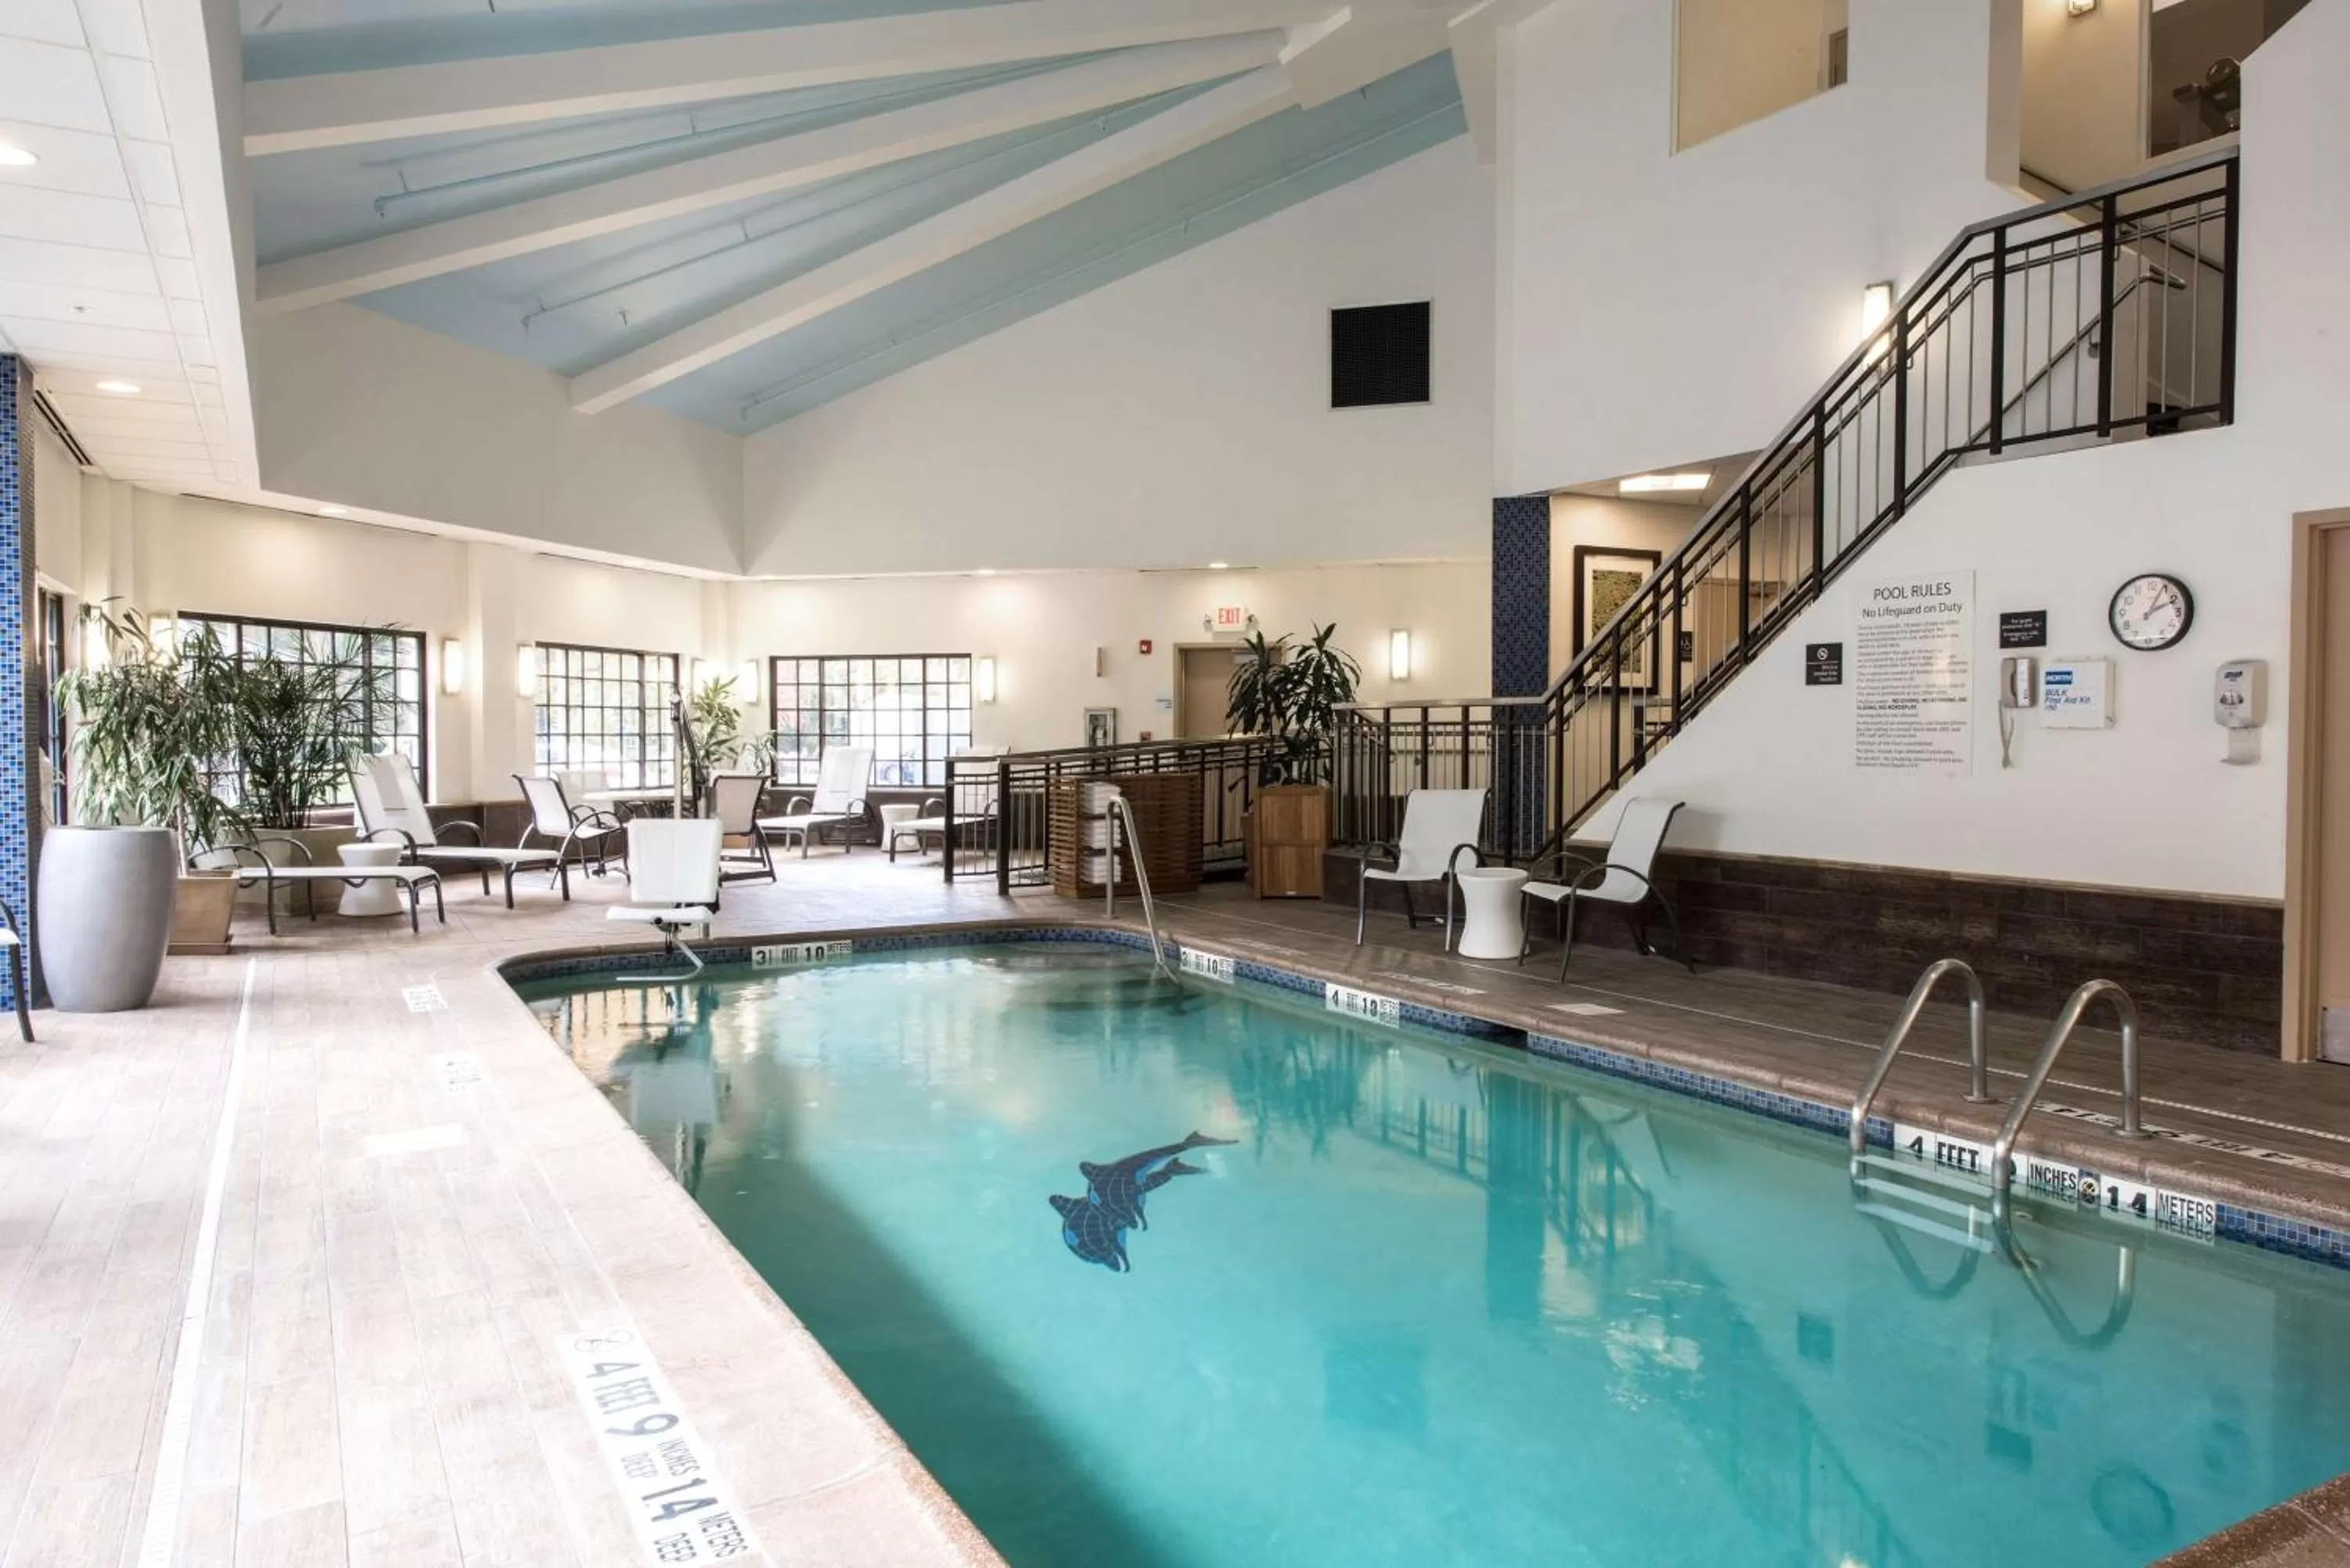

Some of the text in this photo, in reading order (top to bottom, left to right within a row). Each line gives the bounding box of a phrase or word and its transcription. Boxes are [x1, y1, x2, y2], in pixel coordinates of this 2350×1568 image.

[1873, 582, 1951, 601] POOL RULES
[1219, 607, 1240, 624] EXIT
[1862, 602, 1962, 617] No Lifeguard on Duty
[2079, 695, 2092, 703] Kit
[805, 946, 825, 962] 10
[1907, 1135, 1923, 1155] 4
[1937, 1141, 1979, 1170] FEET
[2030, 1163, 2077, 1189] INCHES
[2159, 1193, 2214, 1223] METERS
[586, 1362, 642, 1378] 4
[593, 1376, 661, 1414] FEET
[604, 1413, 679, 1436] 9
[656, 1437, 700, 1477] INCHES
[698, 1511, 749, 1558] METERS
[653, 1532, 697, 1563] DEEP
